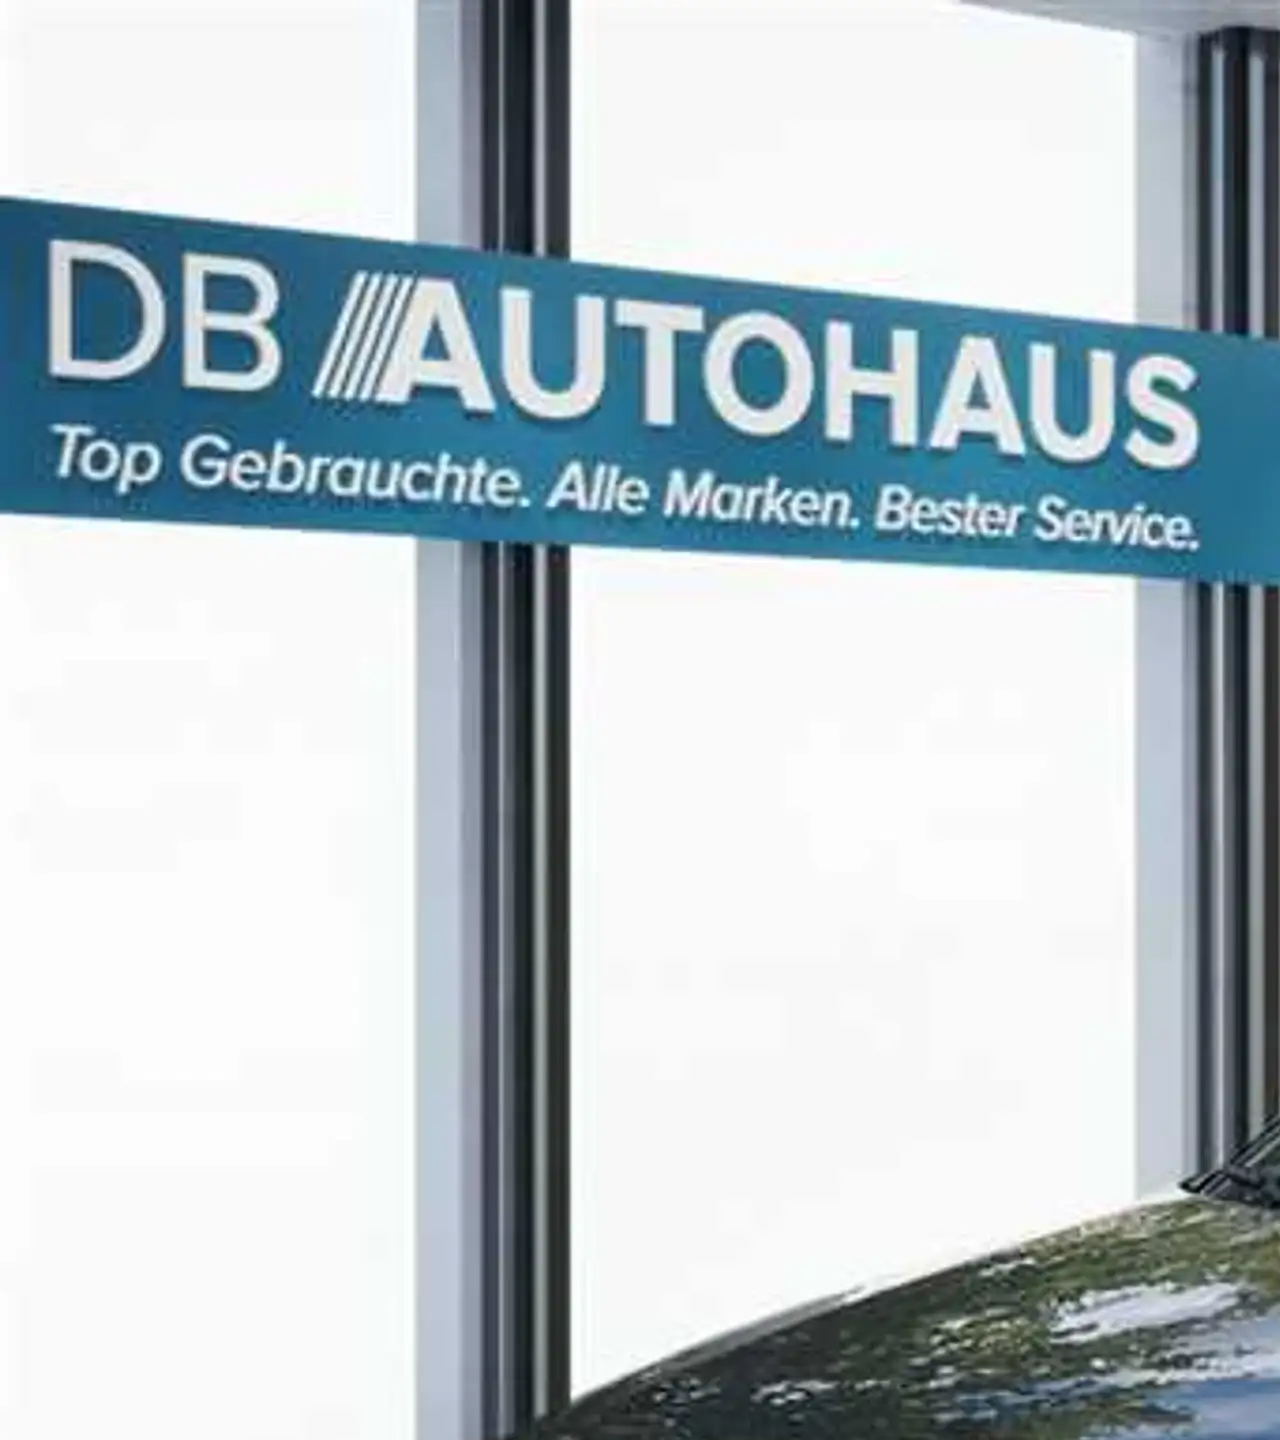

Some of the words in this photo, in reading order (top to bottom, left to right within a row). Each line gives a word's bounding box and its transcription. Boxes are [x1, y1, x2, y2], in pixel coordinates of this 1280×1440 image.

[48, 239, 282, 391] DB
[372, 277, 1200, 470] AUTOHAUS
[49, 424, 162, 496] Top
[180, 433, 531, 509] Gebrauchte.
[547, 460, 650, 516] Alle
[663, 467, 859, 530] Marken.
[874, 483, 1025, 539] Bester
[1033, 495, 1200, 552] Service.
